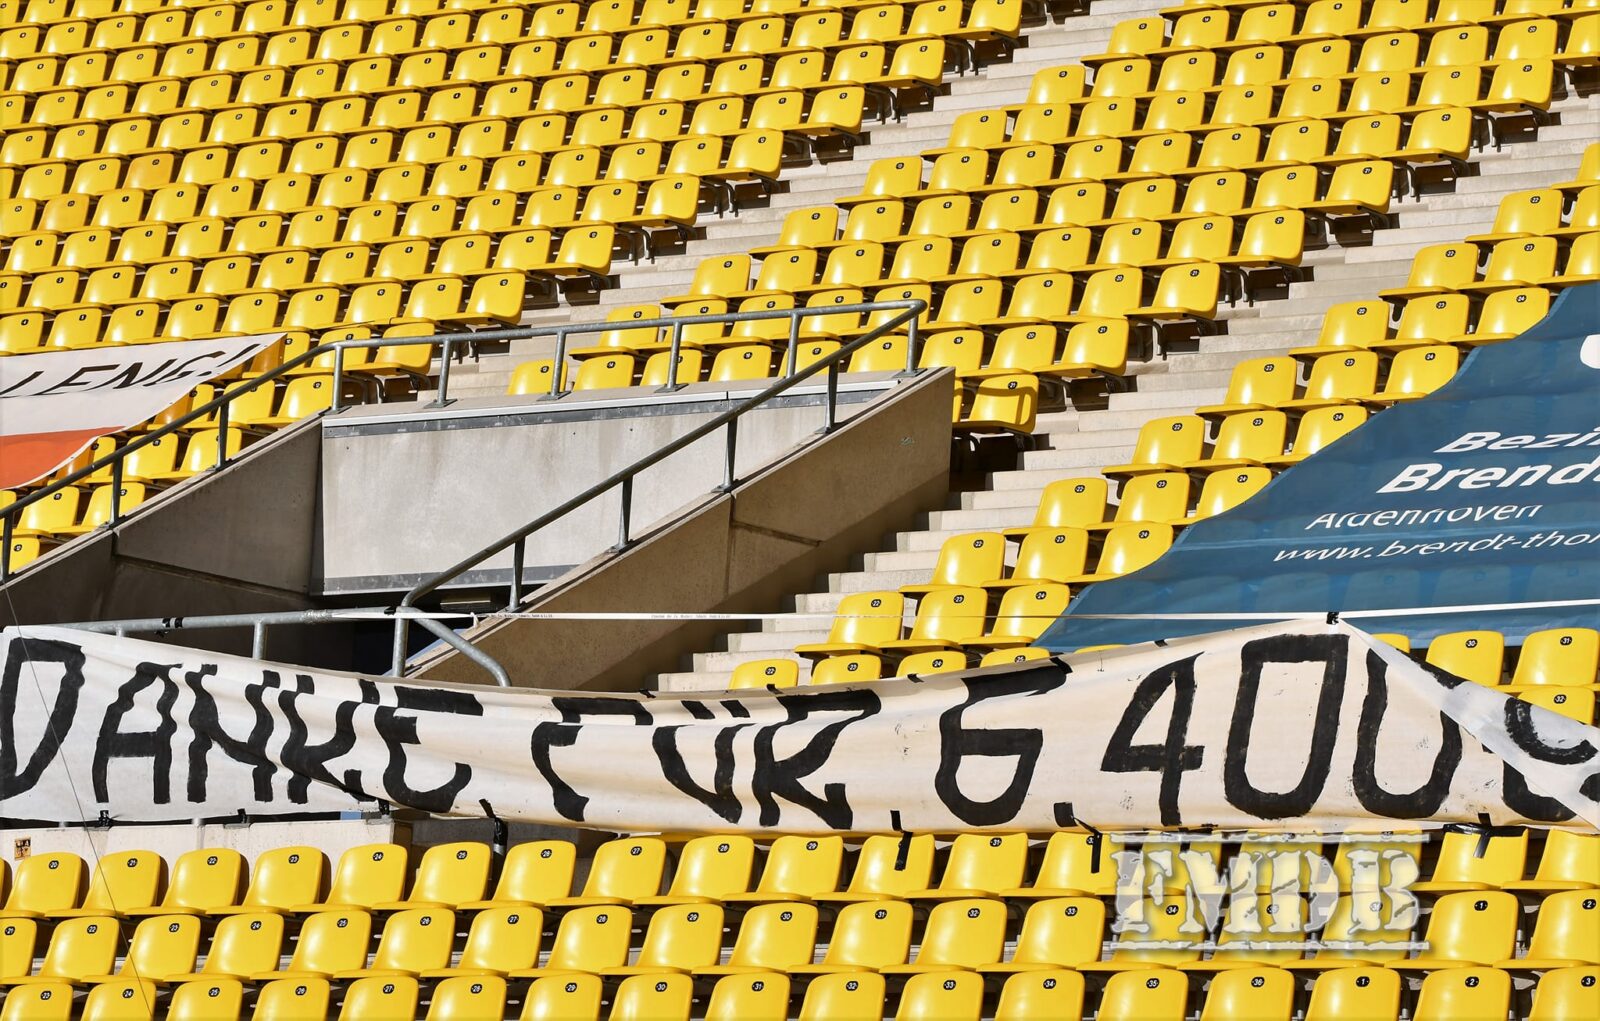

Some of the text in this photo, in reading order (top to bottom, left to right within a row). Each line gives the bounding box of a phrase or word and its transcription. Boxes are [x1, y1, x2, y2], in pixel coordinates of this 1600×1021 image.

[1432, 426, 1600, 453] Bezi
[1375, 455, 1600, 494] Brend
[0, 637, 483, 813] DANKE
[531, 689, 881, 829] FÜR
